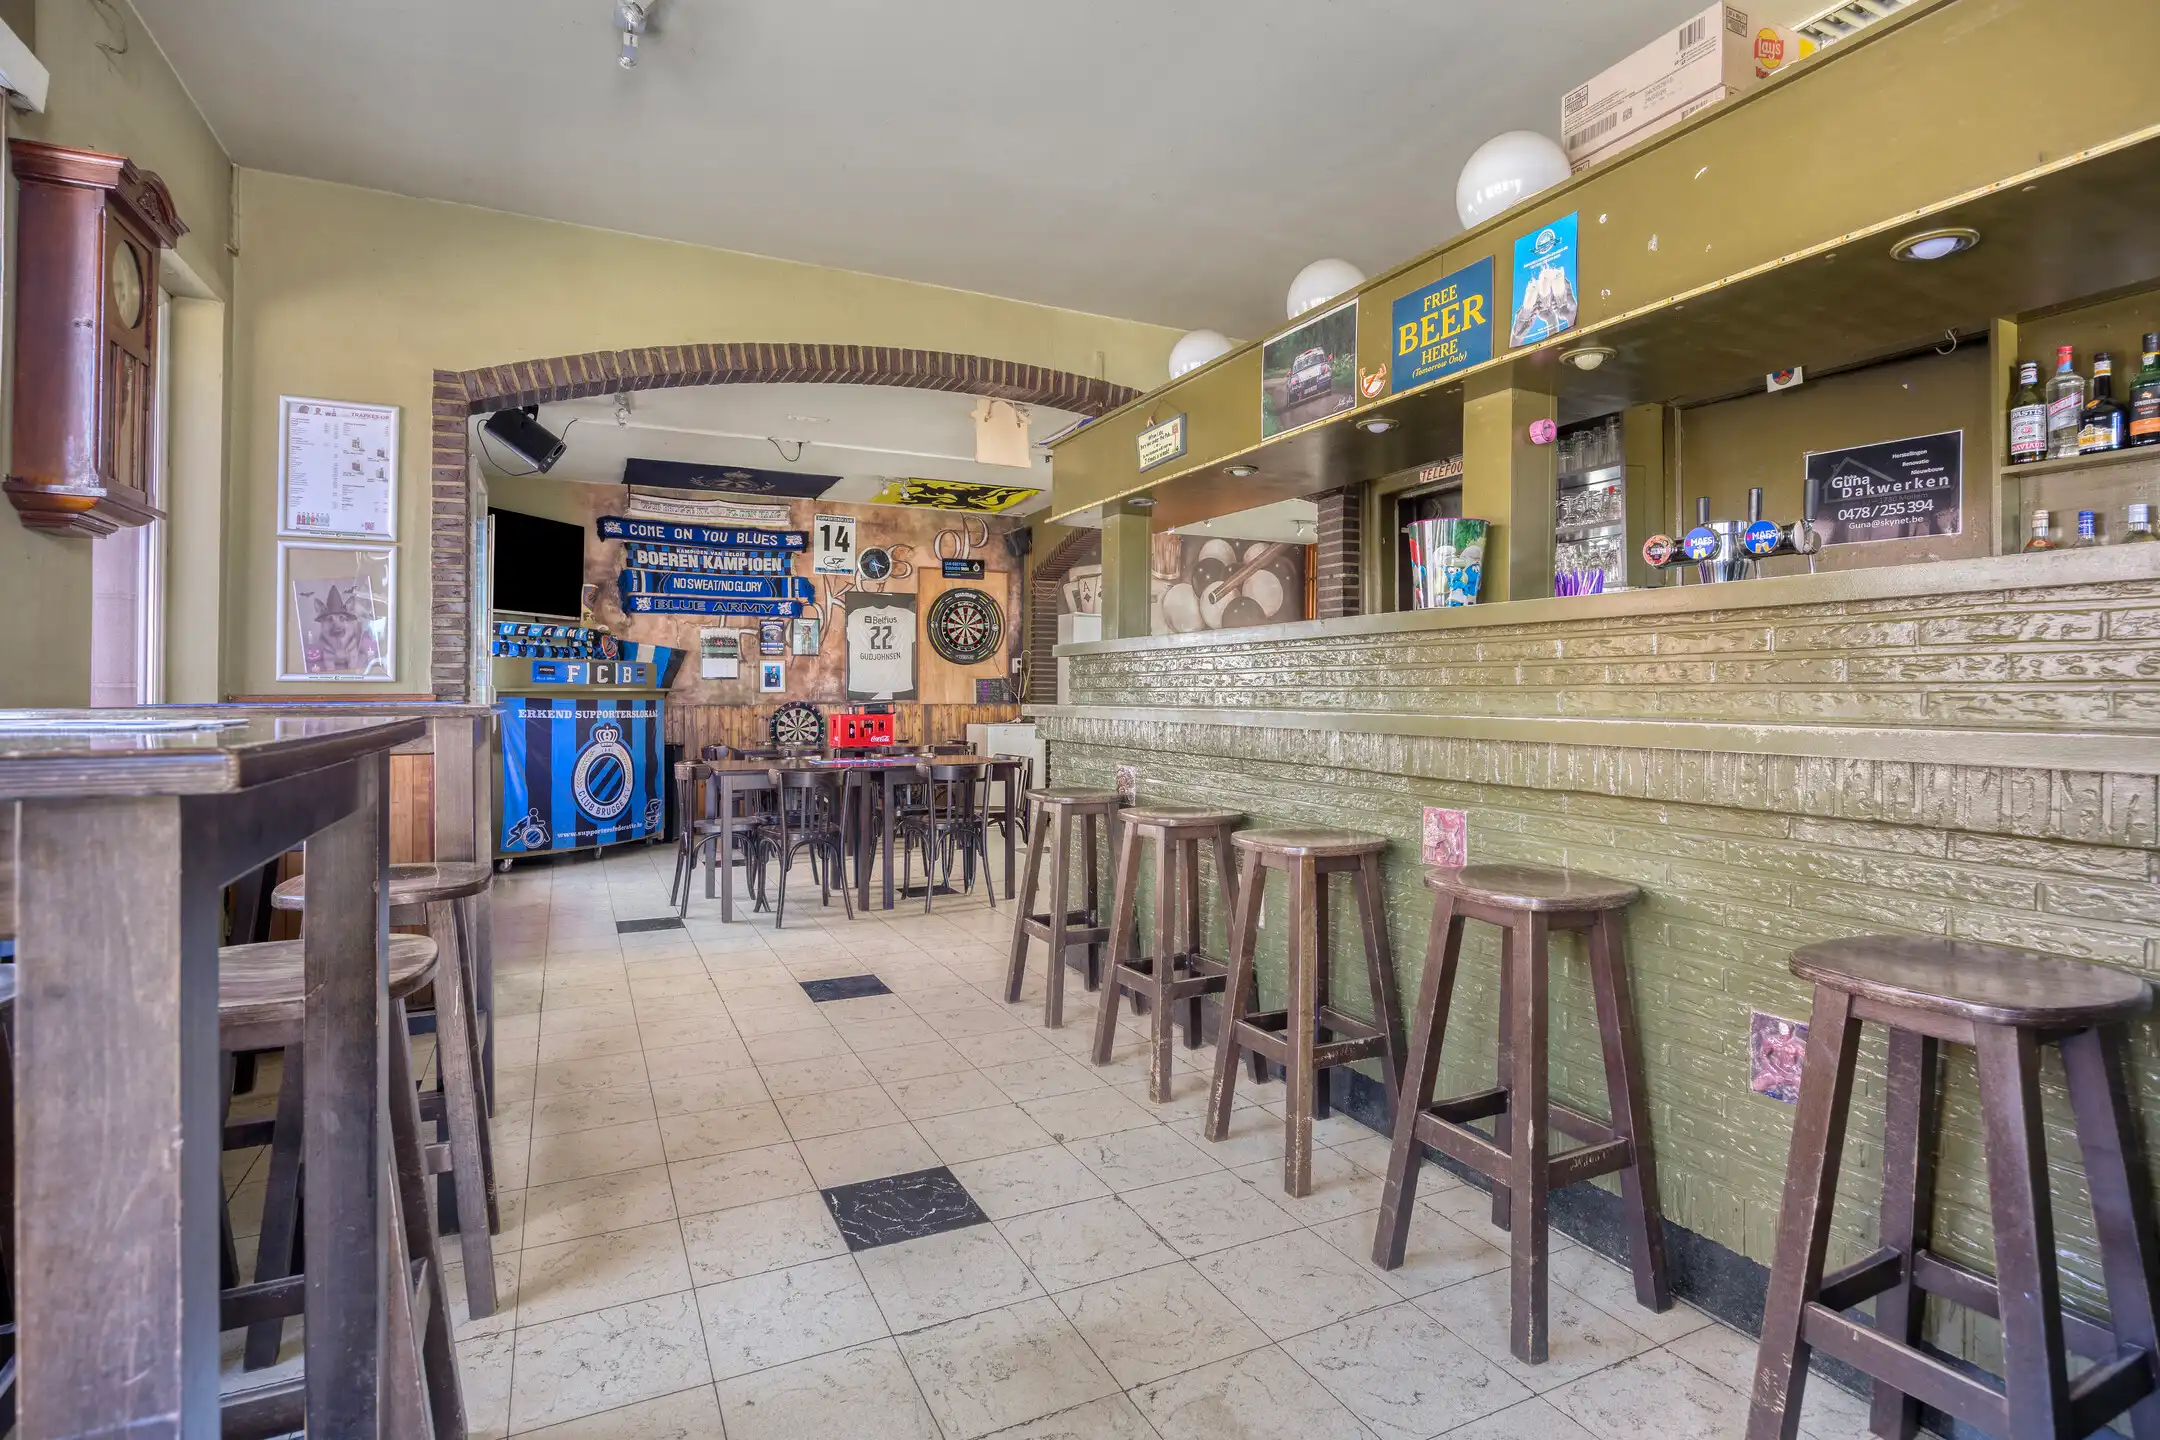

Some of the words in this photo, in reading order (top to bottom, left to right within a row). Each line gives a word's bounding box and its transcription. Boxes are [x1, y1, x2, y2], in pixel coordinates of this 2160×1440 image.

[1758, 37, 1781, 60] Lay's
[1423, 284, 1458, 312] FREE
[1398, 294, 1486, 356] BEER
[1421, 338, 1458, 365] HERE
[1412, 361, 1447, 379] (Tomorrow
[1449, 351, 1467, 364] Only)
[2012, 408, 2043, 418] PASTIS
[1892, 449, 1928, 459] Herstellingen
[1902, 459, 1930, 467] Renovatie
[1911, 466, 1945, 475] Nieuwbouw
[1842, 476, 1950, 498] Dakwerken
[1848, 516, 1924, 529] Guna@skynet.be
[629, 523, 665, 538] COME
[674, 528, 693, 540] ON
[702, 531, 729, 543] YOU
[736, 532, 778, 545] BLUES
[820, 524, 850, 552] 14
[1752, 530, 1776, 540] MAES
[1690, 537, 1713, 546] MAES
[637, 550, 699, 568] BOEREN
[703, 555, 782, 571] KAMPIOEN
[673, 578, 687, 589] NO
[734, 580, 763, 592] GLORY
[1083, 581, 1090, 592] A
[655, 600, 705, 611] BLUE
[713, 602, 775, 613] ARMY
[872, 616, 897, 624] Belfius
[870, 626, 893, 650] 22
[860, 652, 901, 660] GUDJOHNSEN
[518, 709, 572, 719] ERKEND
[577, 790, 594, 811] CLUB
[595, 800, 624, 816] BRUGGE
